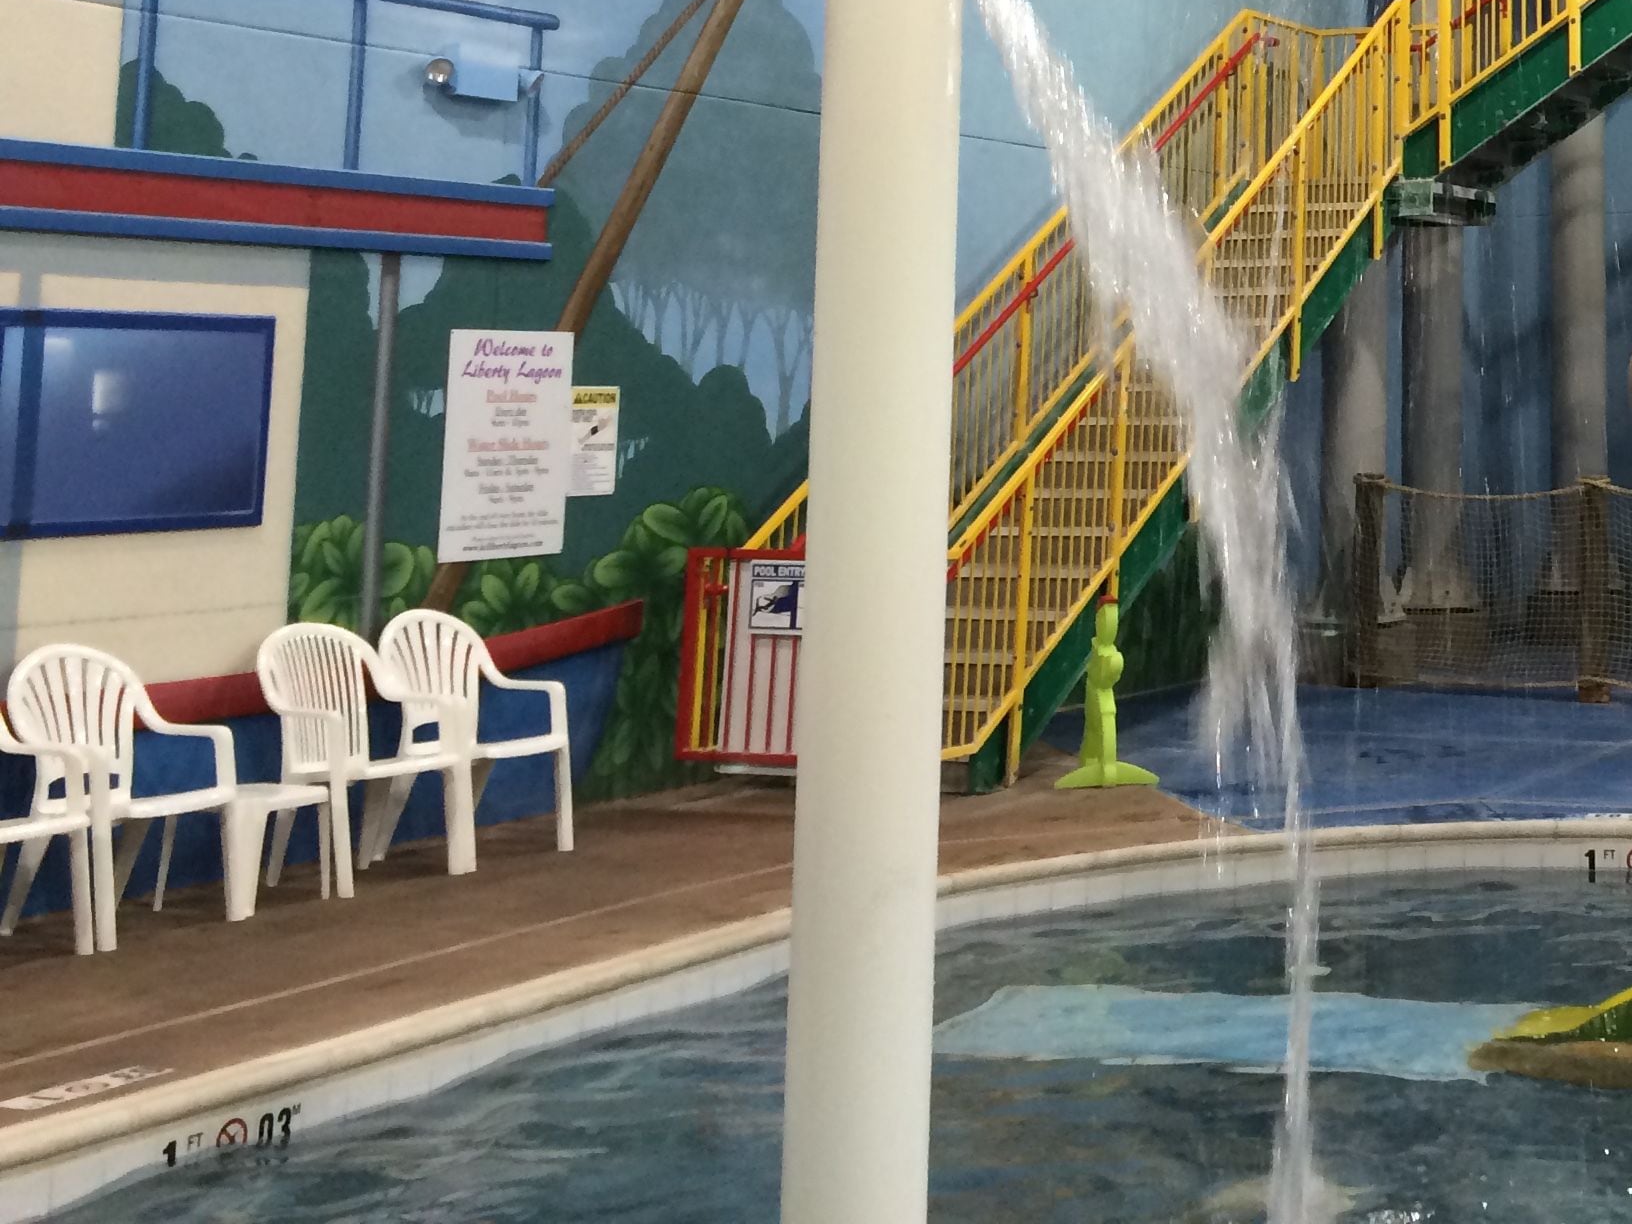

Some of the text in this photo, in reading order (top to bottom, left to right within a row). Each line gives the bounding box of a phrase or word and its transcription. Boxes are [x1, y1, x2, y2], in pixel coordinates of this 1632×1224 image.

[474, 338, 553, 357] Welcome to
[462, 360, 562, 384] Liberty Lagoon
[583, 392, 617, 404] CAUTION
[754, 566, 806, 576] POOL ENTRY
[1584, 849, 1596, 878] 1
[1603, 849, 1616, 860] FT
[162, 1140, 178, 1168] 1
